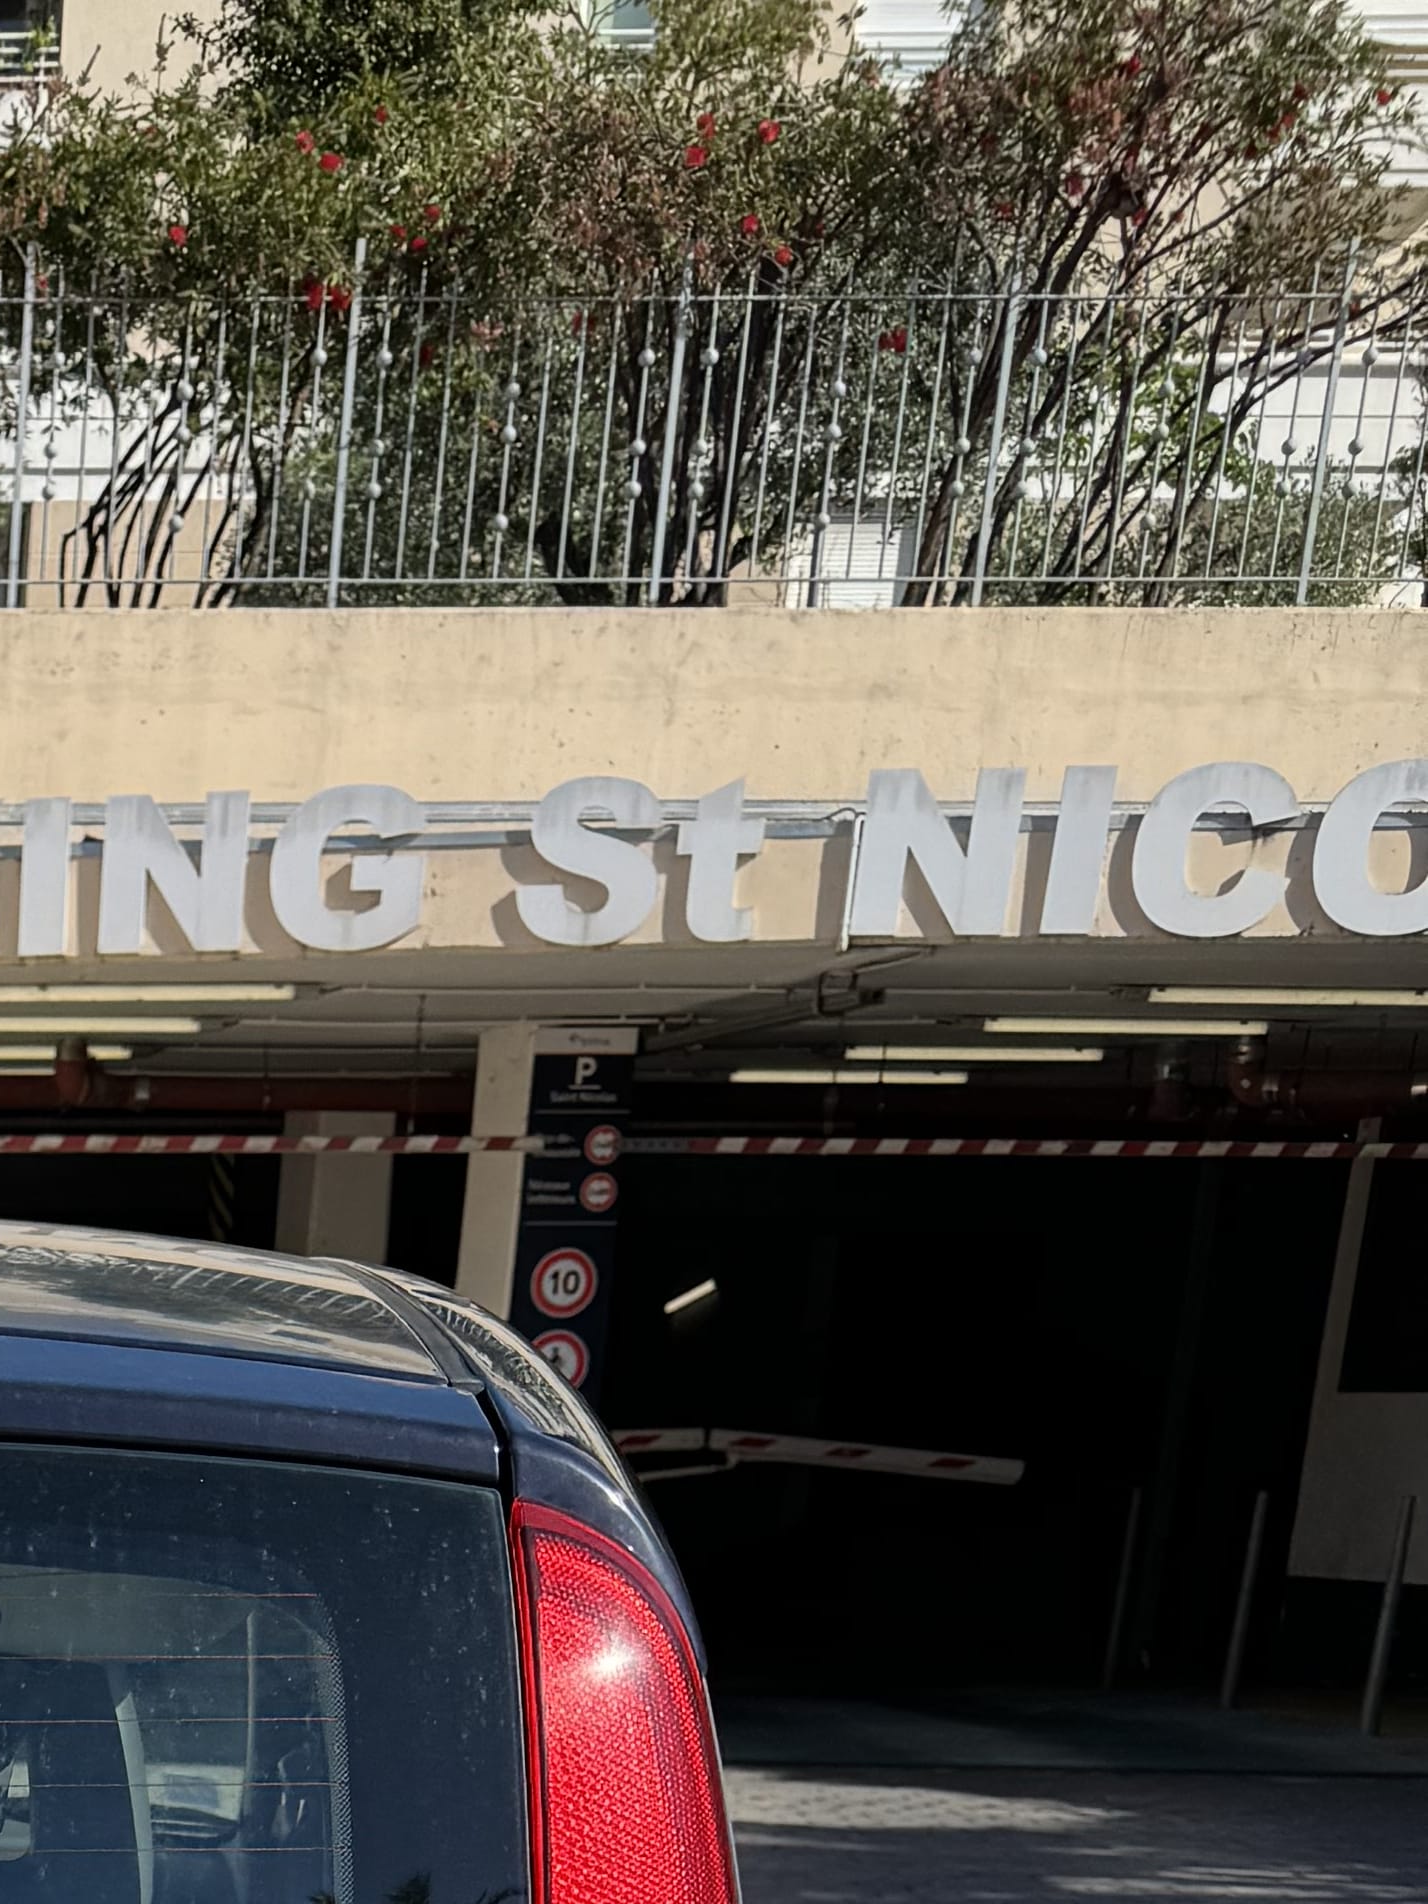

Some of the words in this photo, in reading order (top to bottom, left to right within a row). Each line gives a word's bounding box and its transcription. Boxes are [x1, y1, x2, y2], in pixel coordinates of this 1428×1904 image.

[515, 775, 766, 946] St
[847, 758, 1428, 938] NICO
[574, 1056, 597, 1085] P
[550, 1269, 581, 1295] 10
